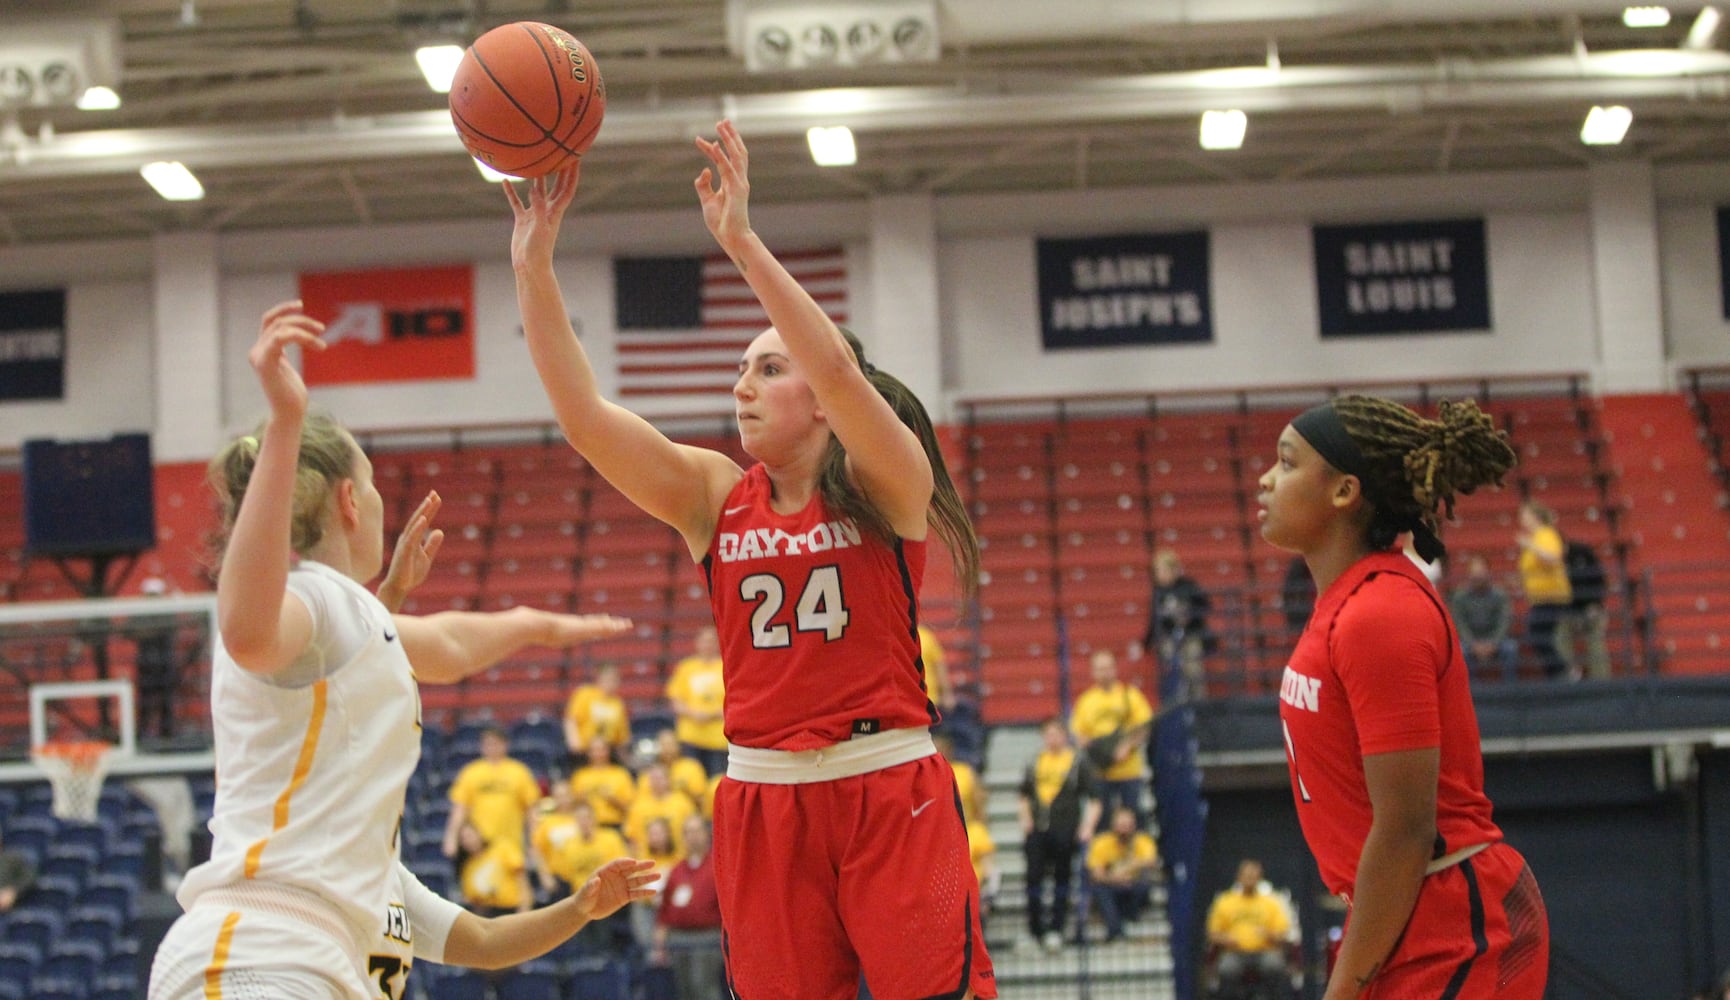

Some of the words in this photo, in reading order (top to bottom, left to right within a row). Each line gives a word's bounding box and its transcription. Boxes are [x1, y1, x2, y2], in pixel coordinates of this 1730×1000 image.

[1072, 254, 1173, 291] SAINT
[1344, 238, 1455, 275] SAINT
[1052, 293, 1201, 330] JOSEPH'S
[1346, 275, 1456, 314] LOUIS
[718, 517, 862, 563] DAYTON
[740, 563, 849, 649] 24
[860, 721, 871, 732] M
